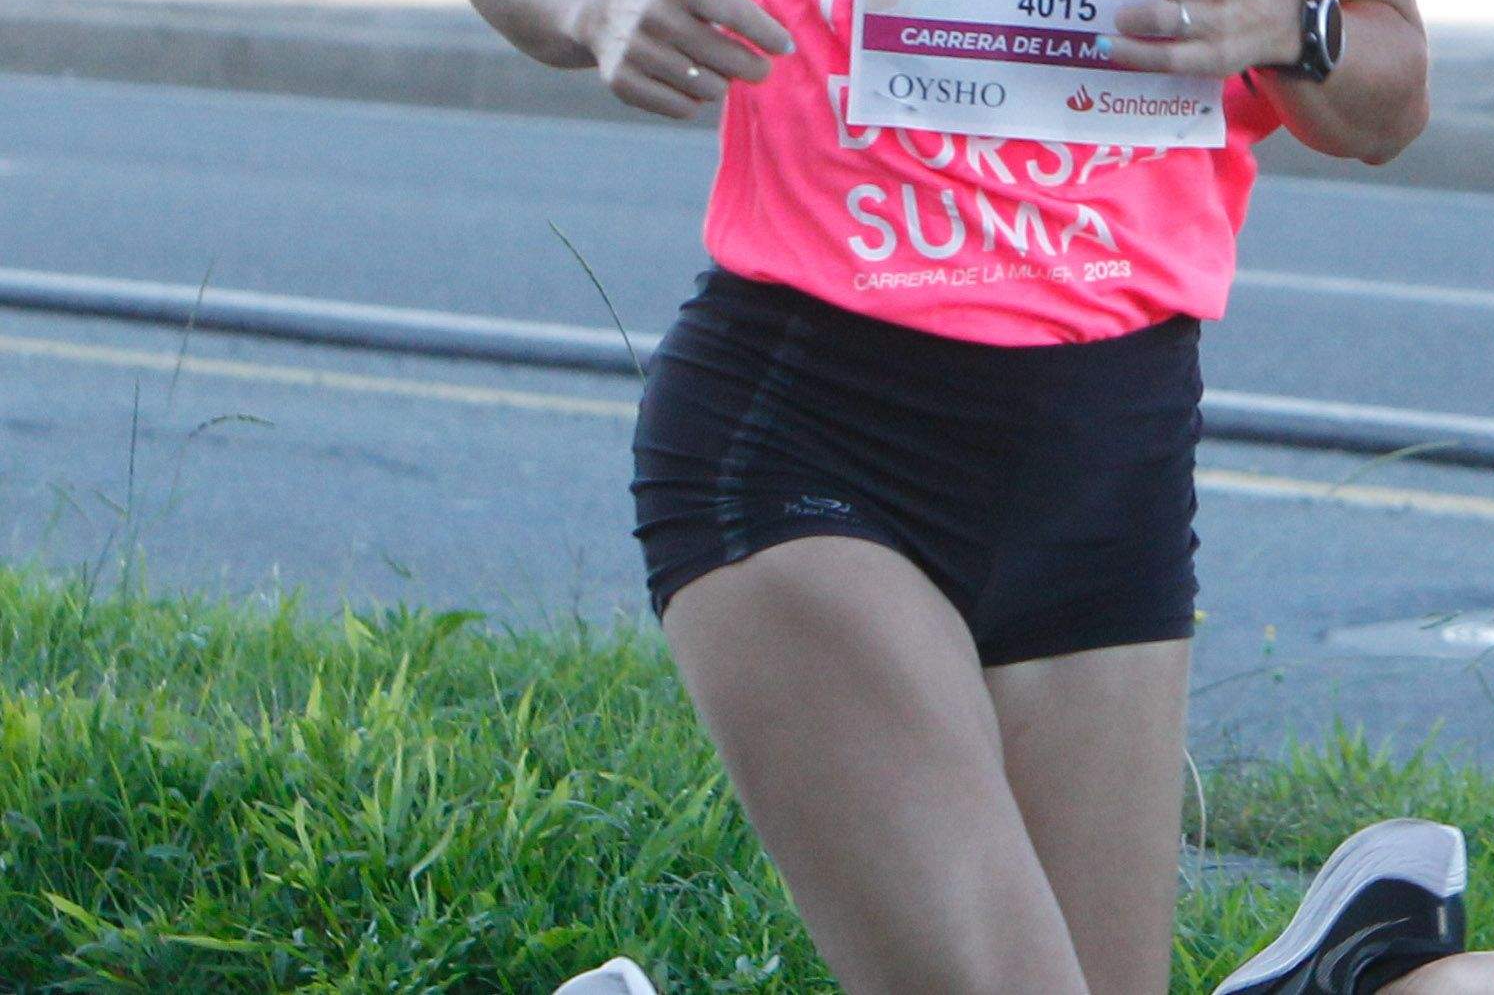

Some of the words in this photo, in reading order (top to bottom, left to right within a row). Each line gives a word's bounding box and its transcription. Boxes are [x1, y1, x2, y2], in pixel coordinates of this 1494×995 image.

[900, 26, 1007, 54] CARRERA
[1012, 36, 1043, 56] DE
[1047, 39, 1073, 57] LA
[889, 72, 1007, 108] OYSHO
[1098, 90, 1200, 118] Santander
[846, 182, 1121, 263] SUMA
[854, 268, 947, 292] CARRERA
[950, 266, 977, 287] DE
[982, 262, 1002, 284] LA
[1083, 259, 1132, 283] 2023
